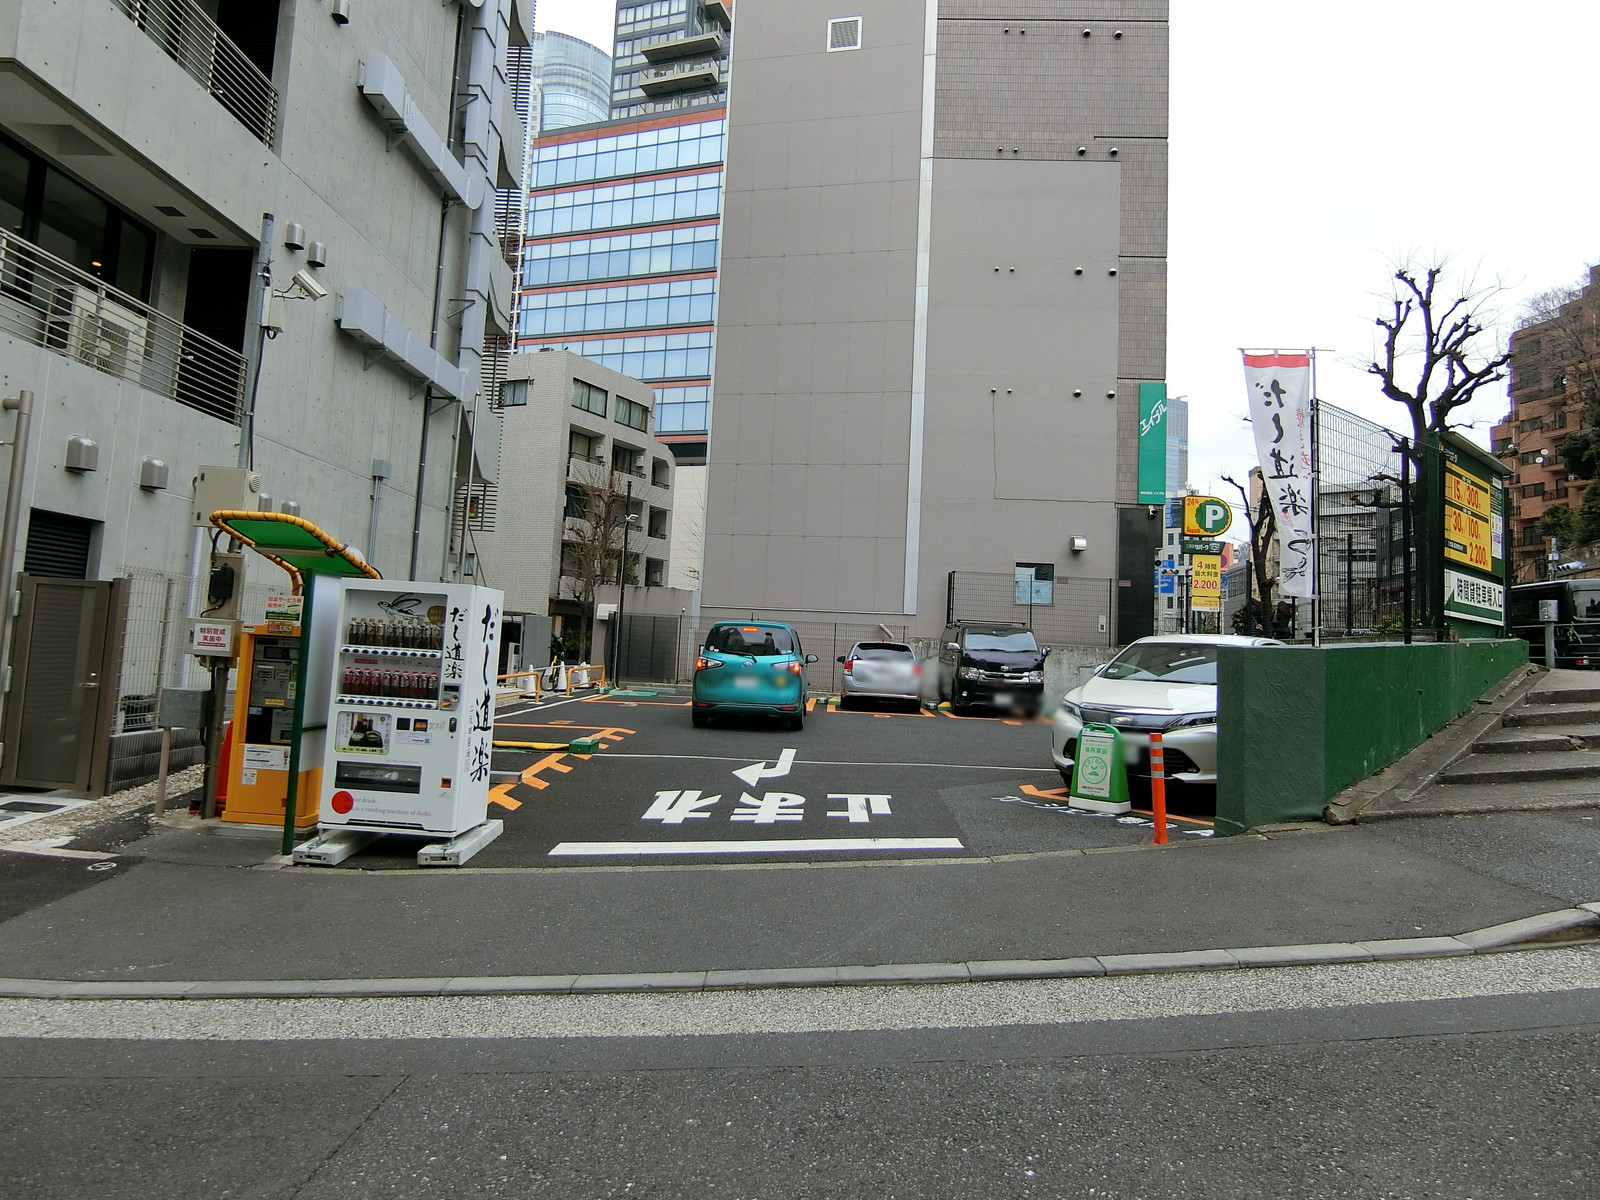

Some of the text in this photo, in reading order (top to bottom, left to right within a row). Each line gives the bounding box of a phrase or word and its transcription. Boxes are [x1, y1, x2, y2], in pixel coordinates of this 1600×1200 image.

[1140, 400, 1167, 434] エイブル
[1205, 504, 1224, 529] P
[1209, 542, 1220, 553] 空
[1194, 569, 1218, 578] 最大料金
[1456, 577, 1502, 608] 時間貸駐車場入口
[200, 627, 226, 636] 特別警戒
[443, 606, 468, 680] だし道楽
[470, 603, 499, 783] だし道楽
[641, 790, 892, 824] 止まれ
